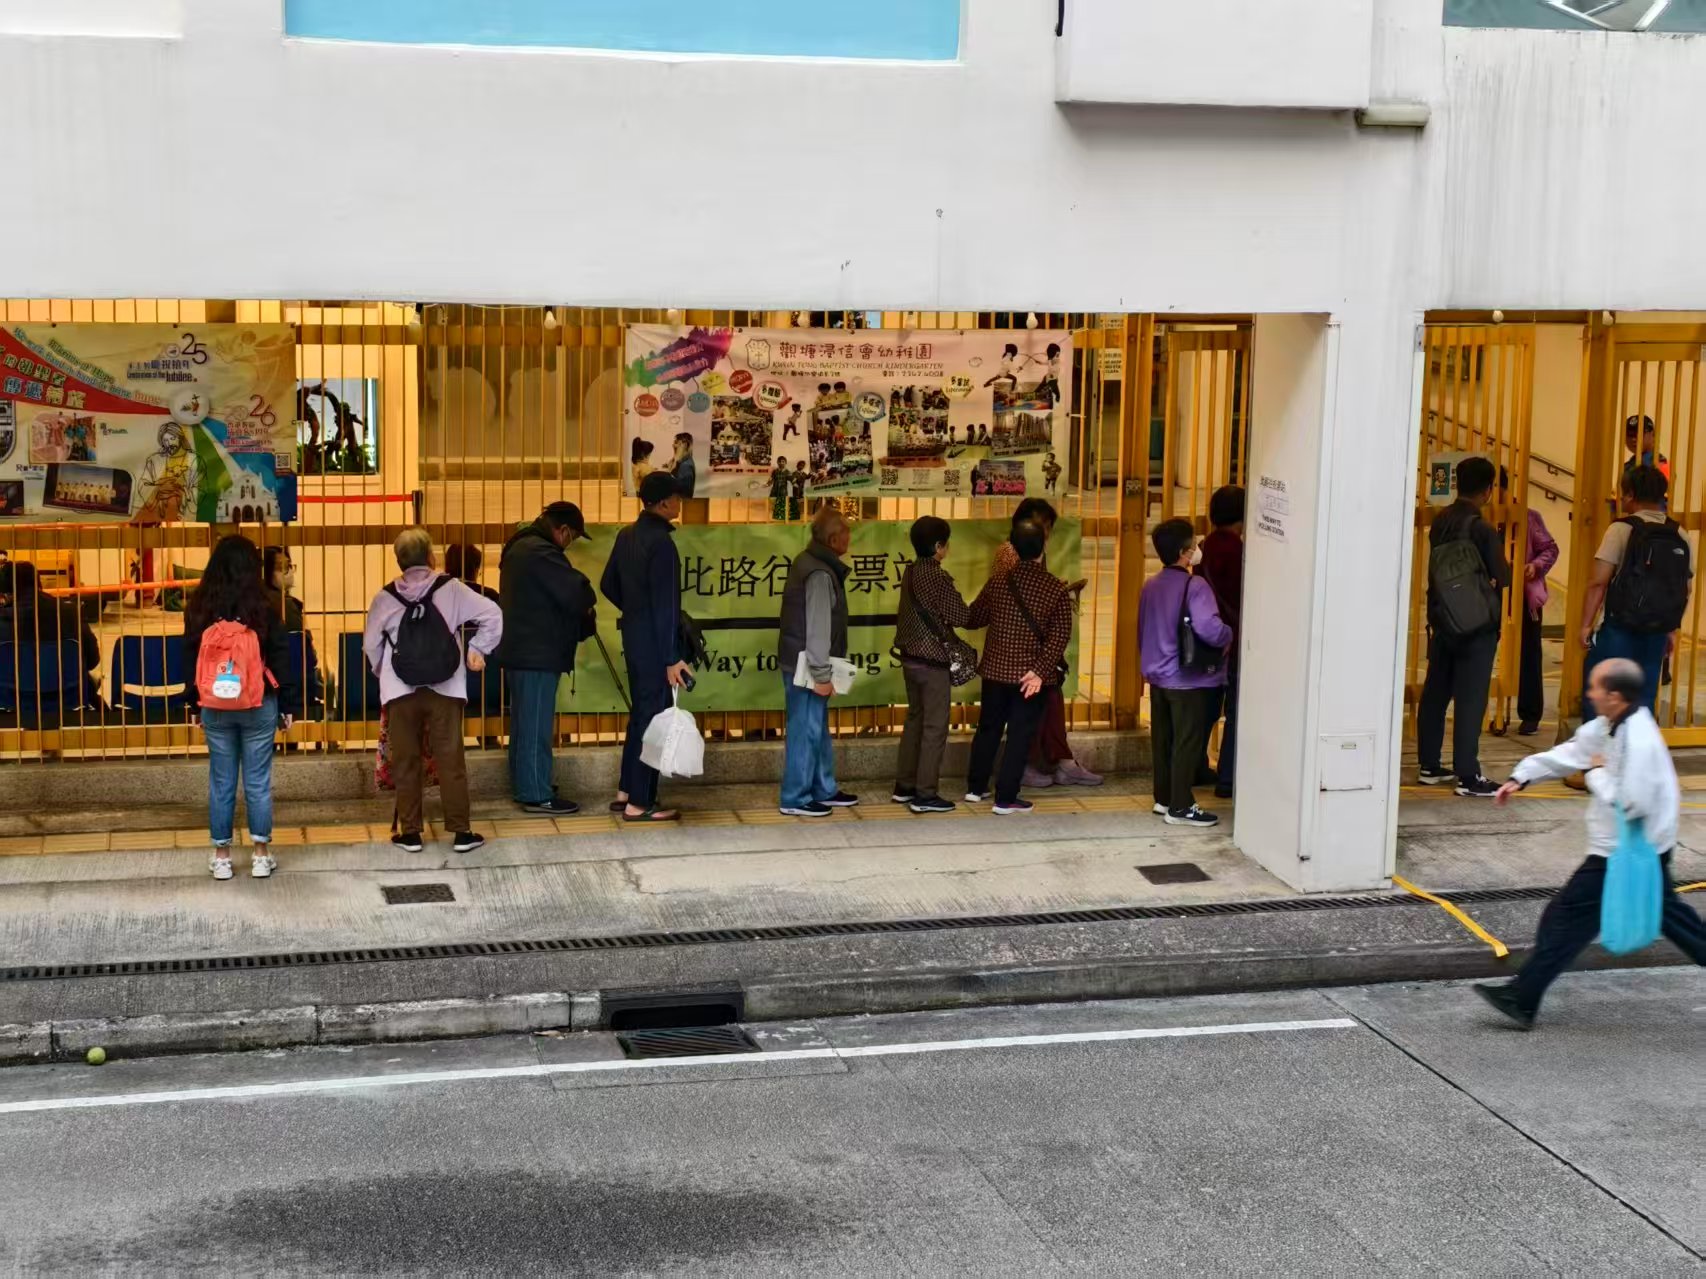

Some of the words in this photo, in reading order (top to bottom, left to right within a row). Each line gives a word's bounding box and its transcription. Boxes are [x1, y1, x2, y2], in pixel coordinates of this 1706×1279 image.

[182, 332, 208, 365] 25
[779, 342, 932, 360] 觀塘浸信會幼稚園
[692, 649, 747, 679] Way
[755, 648, 779, 672] to
